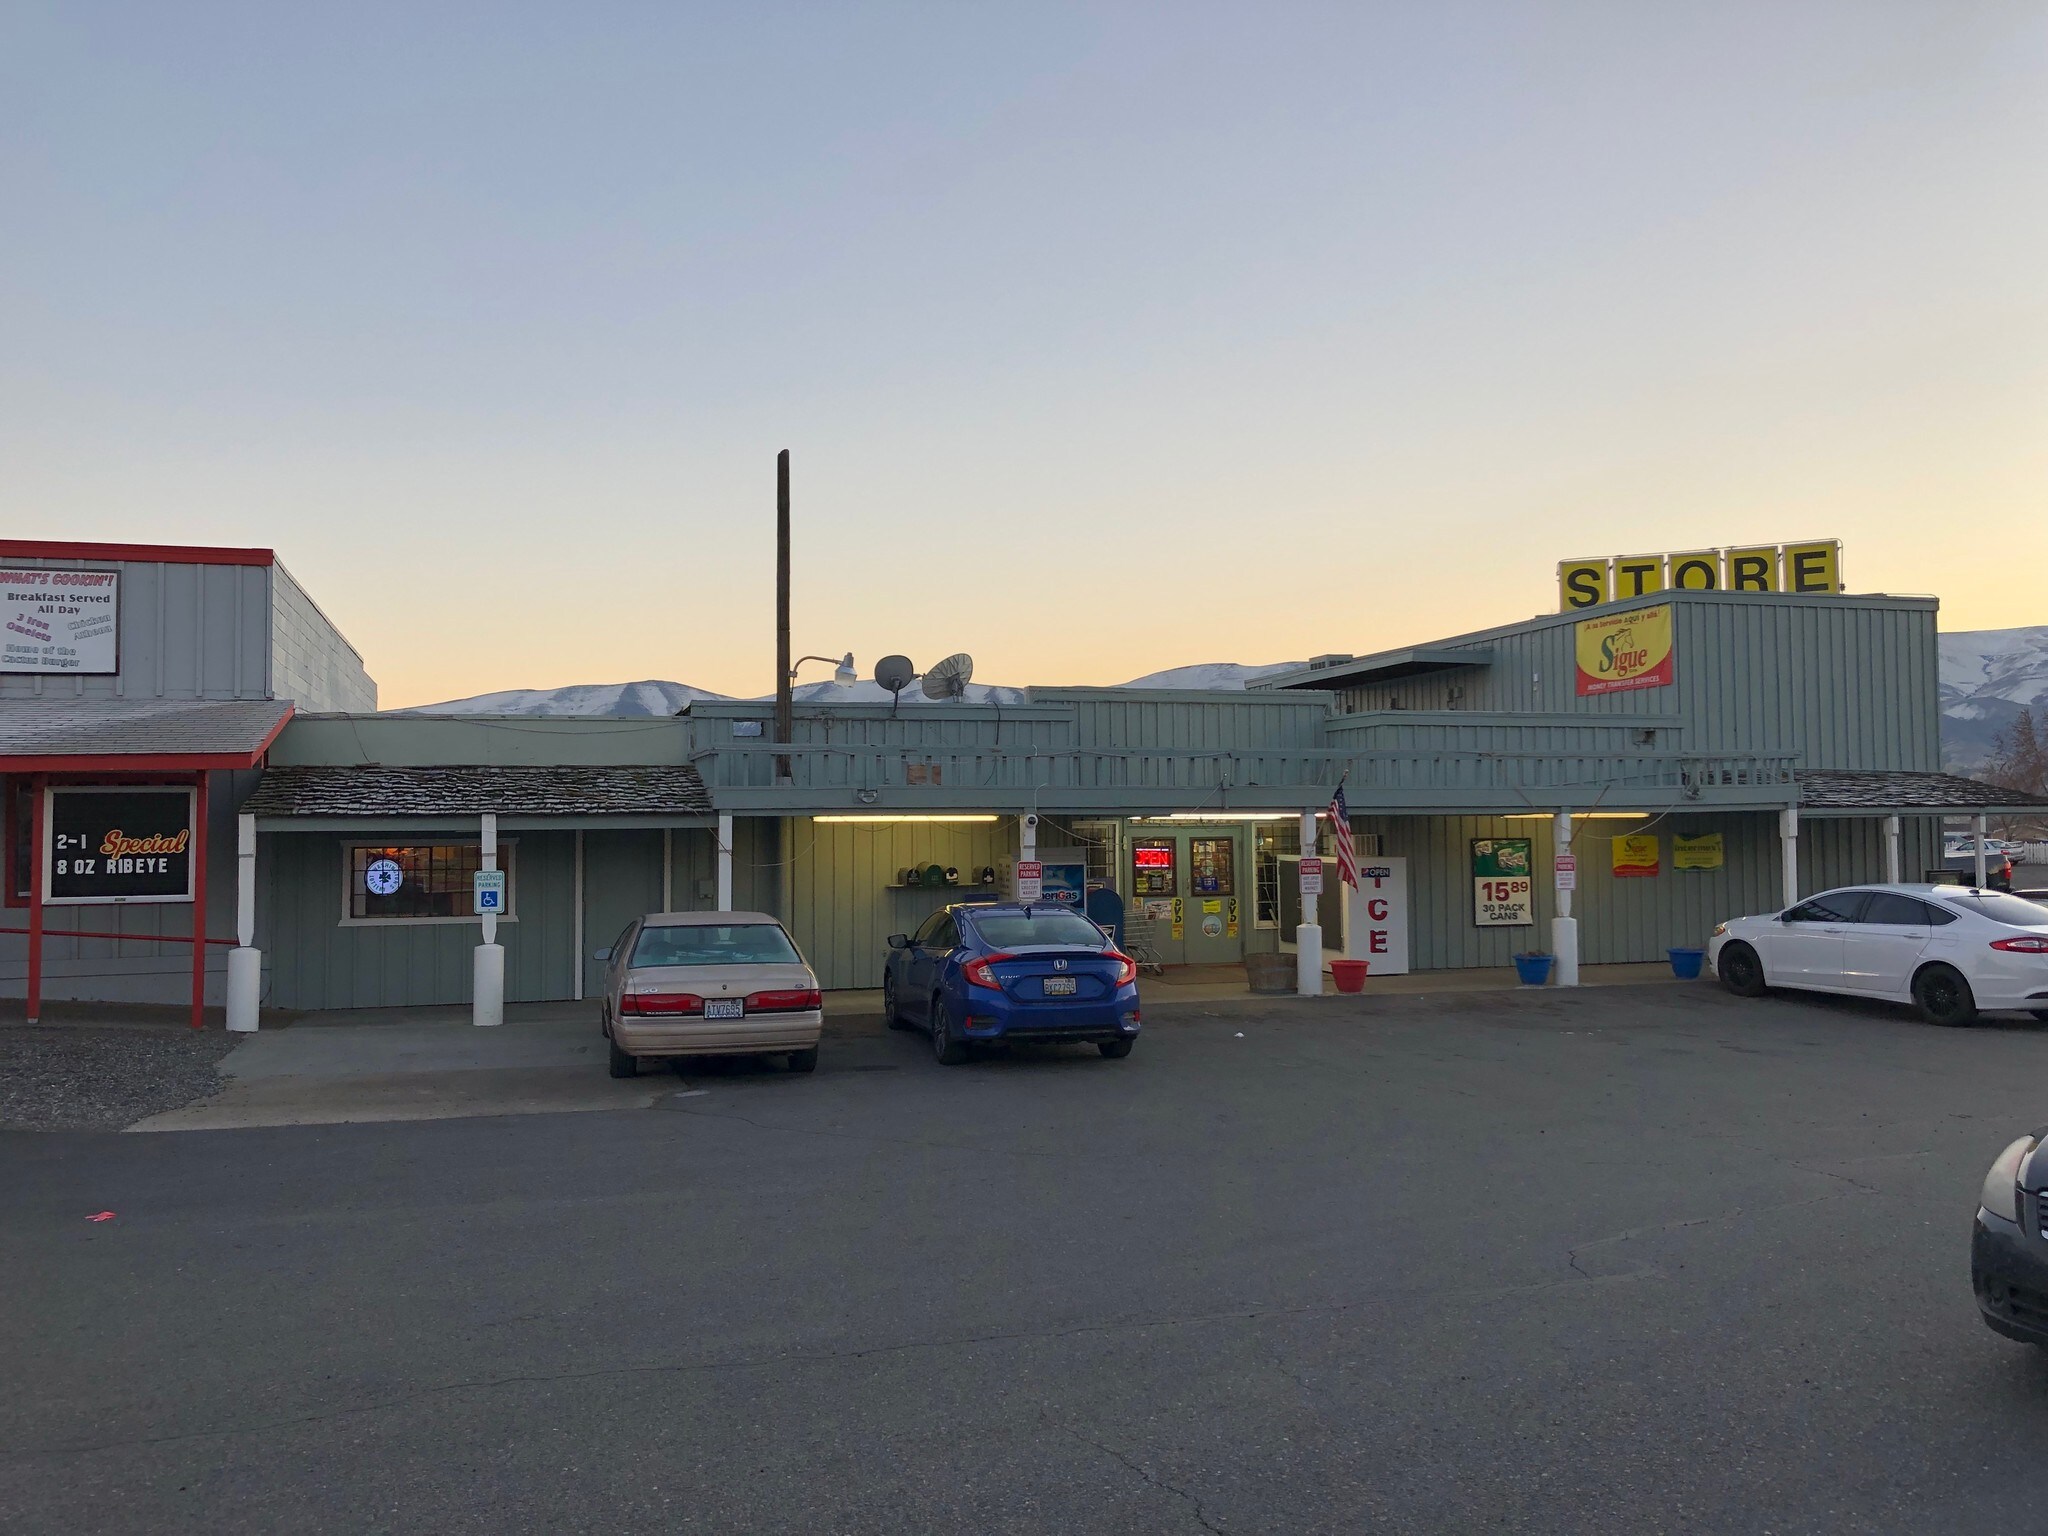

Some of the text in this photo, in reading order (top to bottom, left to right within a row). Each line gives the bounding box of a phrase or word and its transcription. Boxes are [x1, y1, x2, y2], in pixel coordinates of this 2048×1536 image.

[0, 572, 50, 584] WHAT'S
[1567, 550, 1829, 608] STORE
[7, 592, 110, 603] Breakfast Served
[37, 605, 81, 615] All Day
[16, 613, 24, 621] 3
[68, 614, 111, 630] Chicken
[6, 621, 52, 642] Omelets
[6, 644, 76, 655] Home of the
[41, 656, 80, 667] Burger
[1599, 635, 1648, 677] Sigue
[100, 829, 190, 860] Special
[1136, 851, 1168, 865] OPEN
[57, 857, 168, 875] 8 OZ RIBEYE
[1019, 863, 1041, 871] RESERVED
[1020, 870, 1040, 878] PARKING
[1369, 868, 1389, 876] OPEN
[1174, 899, 1182, 923] DVD
[1228, 898, 1237, 922] DVD
[1482, 903, 1526, 913] 30 PACK
[1489, 912, 1519, 921] CANS
